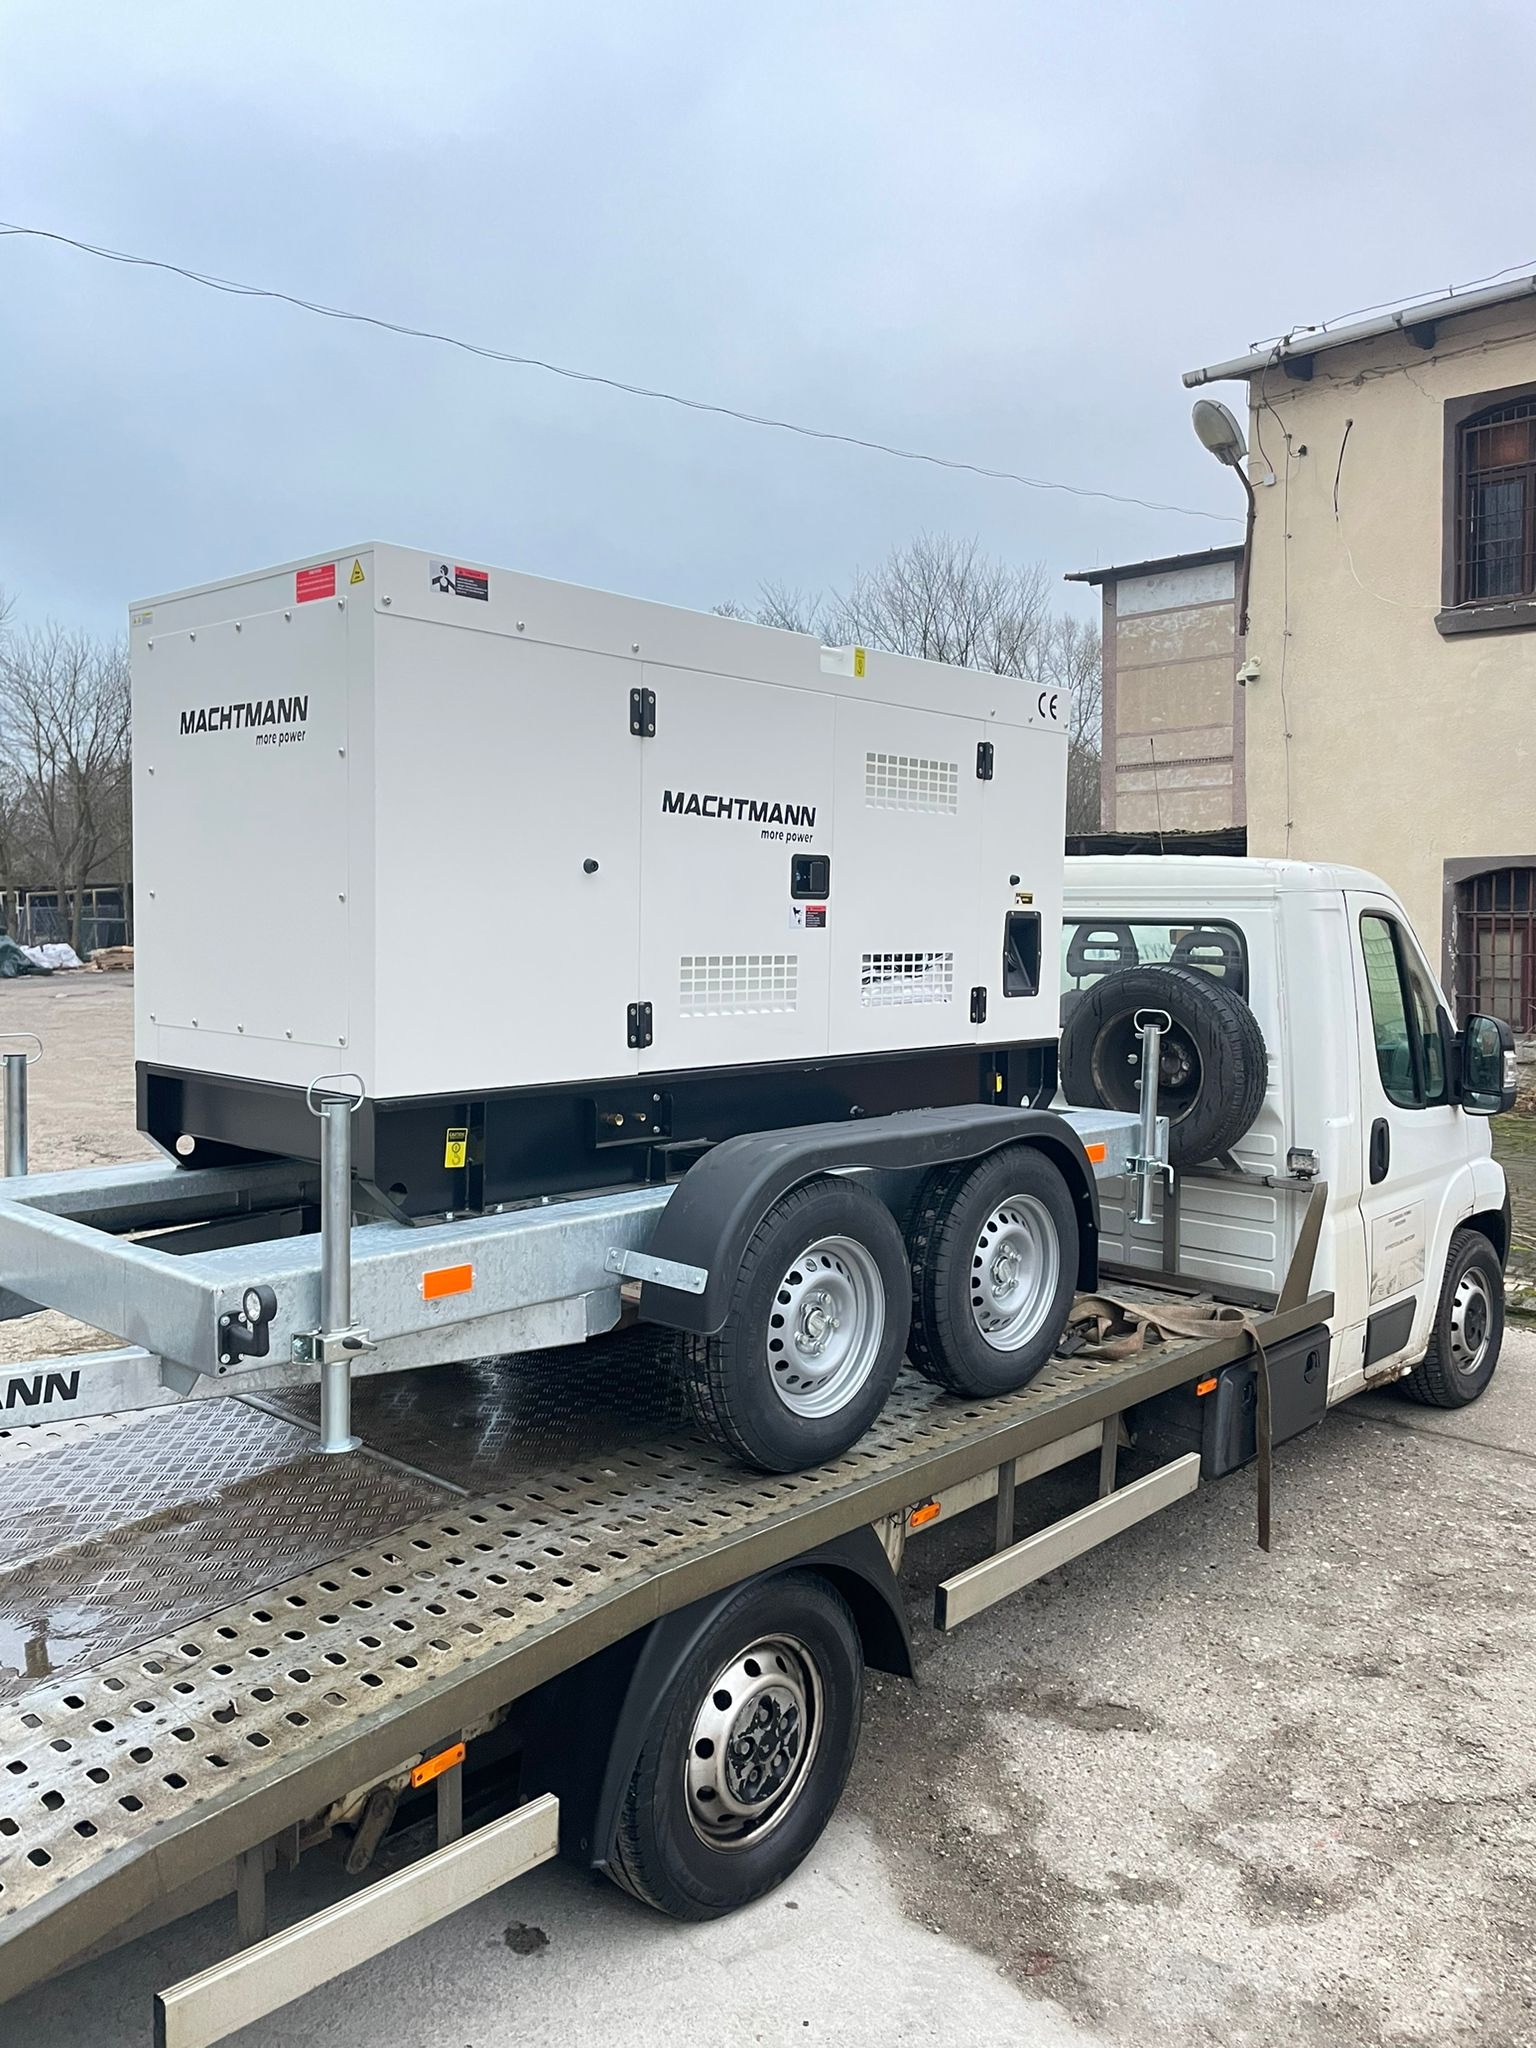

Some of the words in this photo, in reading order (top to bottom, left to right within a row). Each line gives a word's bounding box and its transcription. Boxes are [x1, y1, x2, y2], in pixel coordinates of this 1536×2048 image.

[180, 695, 308, 735] MACHTMANN
[255, 733, 277, 746] more
[278, 730, 306, 747] power
[662, 790, 817, 827] MACHTMANN
[760, 829, 784, 841] more
[785, 832, 813, 844] power
[0, 1370, 81, 1409] NN
